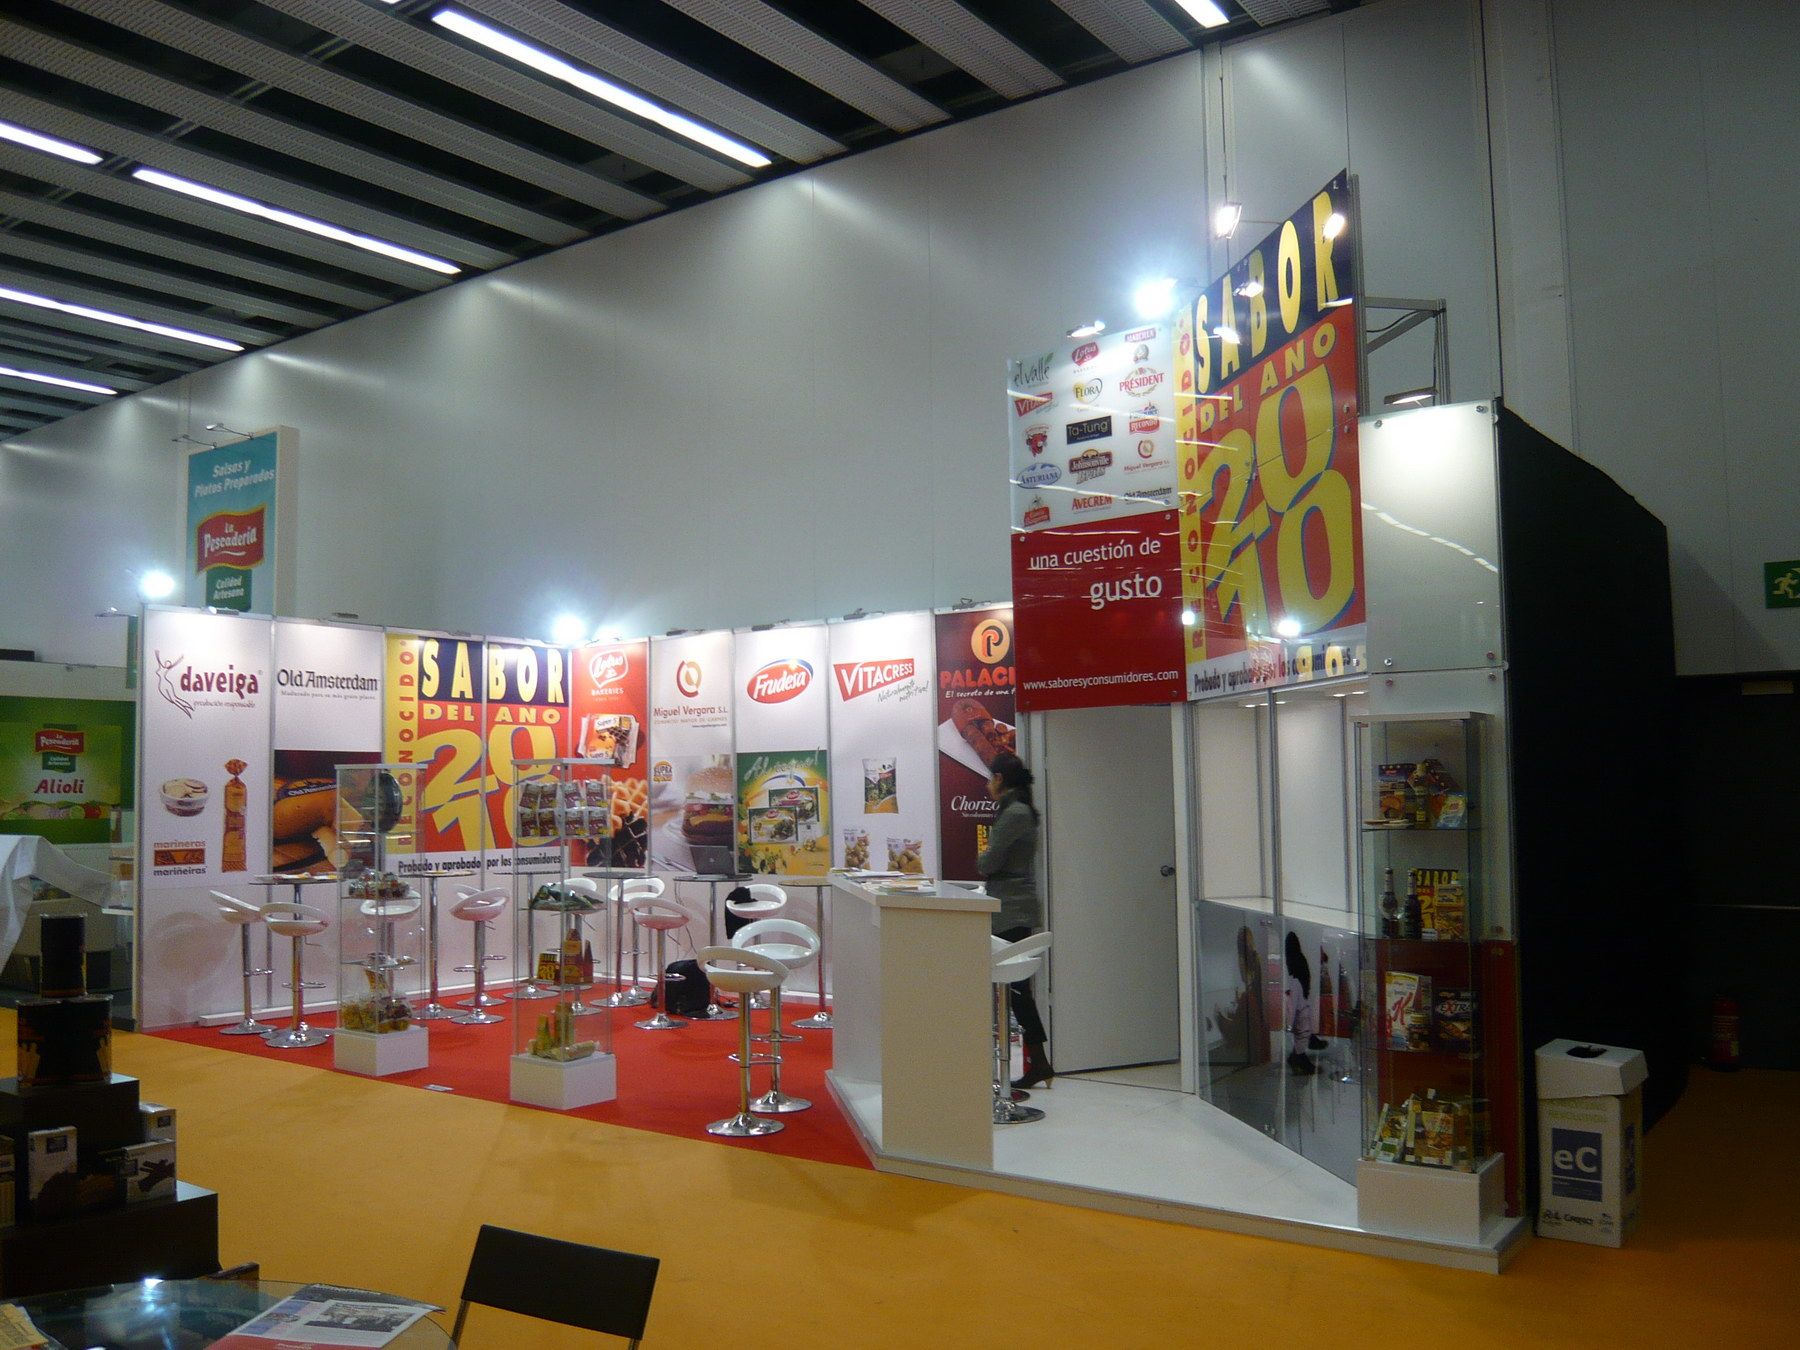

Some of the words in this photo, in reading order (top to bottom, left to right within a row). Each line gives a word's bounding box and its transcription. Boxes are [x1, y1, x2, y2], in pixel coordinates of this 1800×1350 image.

[1196, 191, 1339, 393] SABOR
[1075, 386, 1100, 399] FLORA
[1119, 373, 1164, 391] PRÉSIDENT
[1200, 384, 1243, 433] DEL
[1067, 420, 1108, 436] Ta-Tung
[224, 469, 275, 491] Preparados
[1072, 495, 1112, 510] AVECREM
[1030, 554, 1058, 570] una
[1064, 539, 1133, 565] cuestión
[1139, 537, 1161, 555] de
[1090, 573, 1162, 610] gusto
[180, 665, 259, 700] daveiga
[277, 669, 304, 687] Old
[305, 671, 379, 692] Amsterdam
[421, 638, 564, 704] SABOR
[841, 661, 914, 695] VITACRESS
[940, 666, 1016, 689] PALACI
[1023, 670, 1179, 690] www.saboresyconsumidores.com
[1194, 668, 1221, 693] Probado
[753, 671, 806, 699] Frudesa
[423, 703, 475, 722] DEL
[654, 705, 681, 719] Miguel
[683, 705, 716, 717] Vergara
[398, 651, 414, 847] RECONOCIDO
[415, 725, 557, 814] 20
[34, 779, 85, 794] Alioli
[951, 795, 1000, 812] Chorizo
[153, 839, 206, 848] marineras
[398, 859, 433, 873] Probado
[434, 863, 440, 872] y
[442, 857, 481, 870] aprobado
[486, 859, 499, 869] por
[501, 855, 512, 867] los
